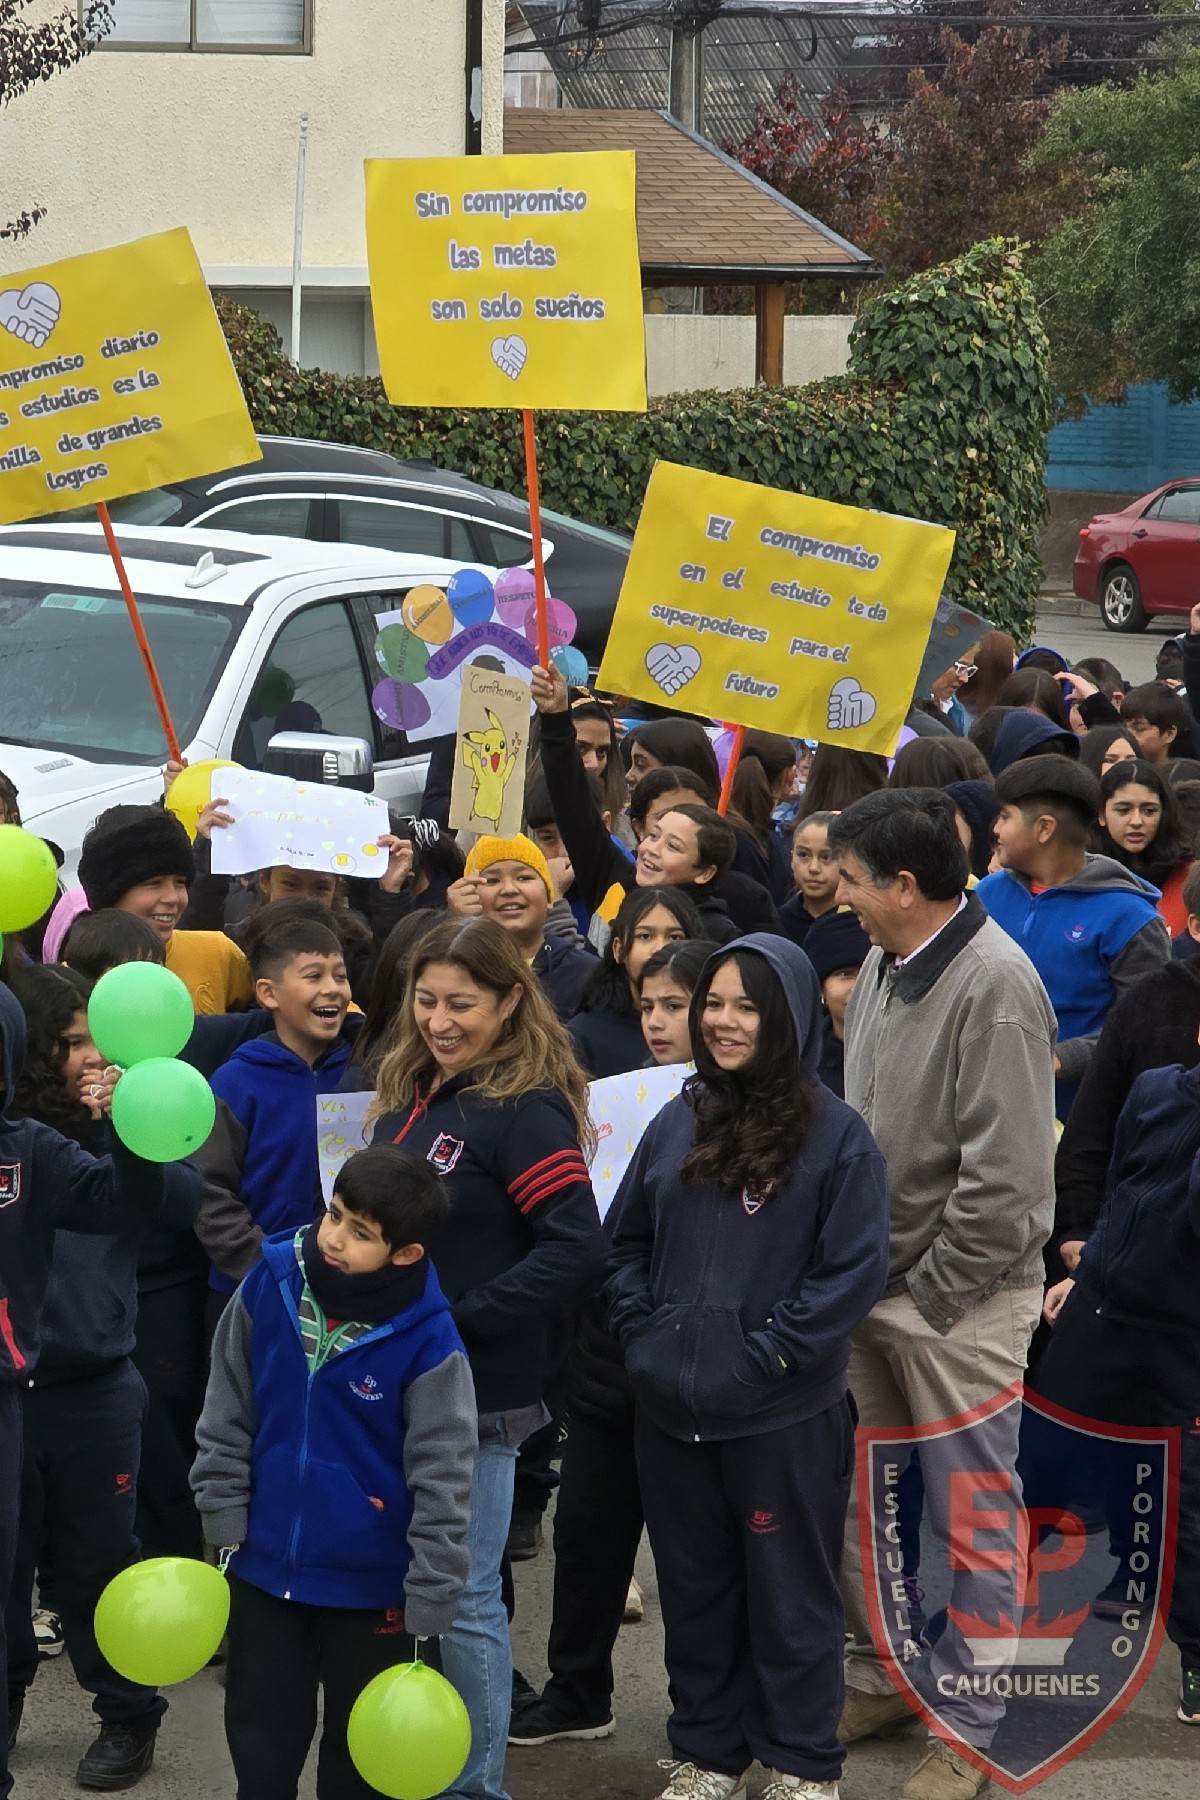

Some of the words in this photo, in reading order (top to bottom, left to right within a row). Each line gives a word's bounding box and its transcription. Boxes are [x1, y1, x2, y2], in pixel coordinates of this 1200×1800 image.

[415, 192, 450, 217] Sin
[463, 187, 587, 218] compromiso
[451, 243, 480, 269] las
[494, 240, 556, 266] metas
[432, 300, 466, 319] son
[480, 293, 522, 318] solo
[535, 294, 605, 318] sueños
[101, 330, 159, 358] diario
[21, 387, 99, 417] estudios
[112, 377, 135, 394] es
[139, 370, 159, 388] la
[58, 434, 83, 453] de
[87, 416, 162, 450] grandes
[47, 463, 108, 490] logros
[707, 516, 732, 541] El
[760, 528, 880, 570] compromiso
[680, 563, 706, 582] en
[722, 569, 745, 589] el
[770, 582, 831, 608] estudio
[847, 596, 864, 615] te
[868, 603, 887, 621] da
[650, 604, 768, 642] superpoderes
[790, 638, 828, 658] para
[832, 646, 850, 662] el
[398, 631, 410, 676] AMISTAD
